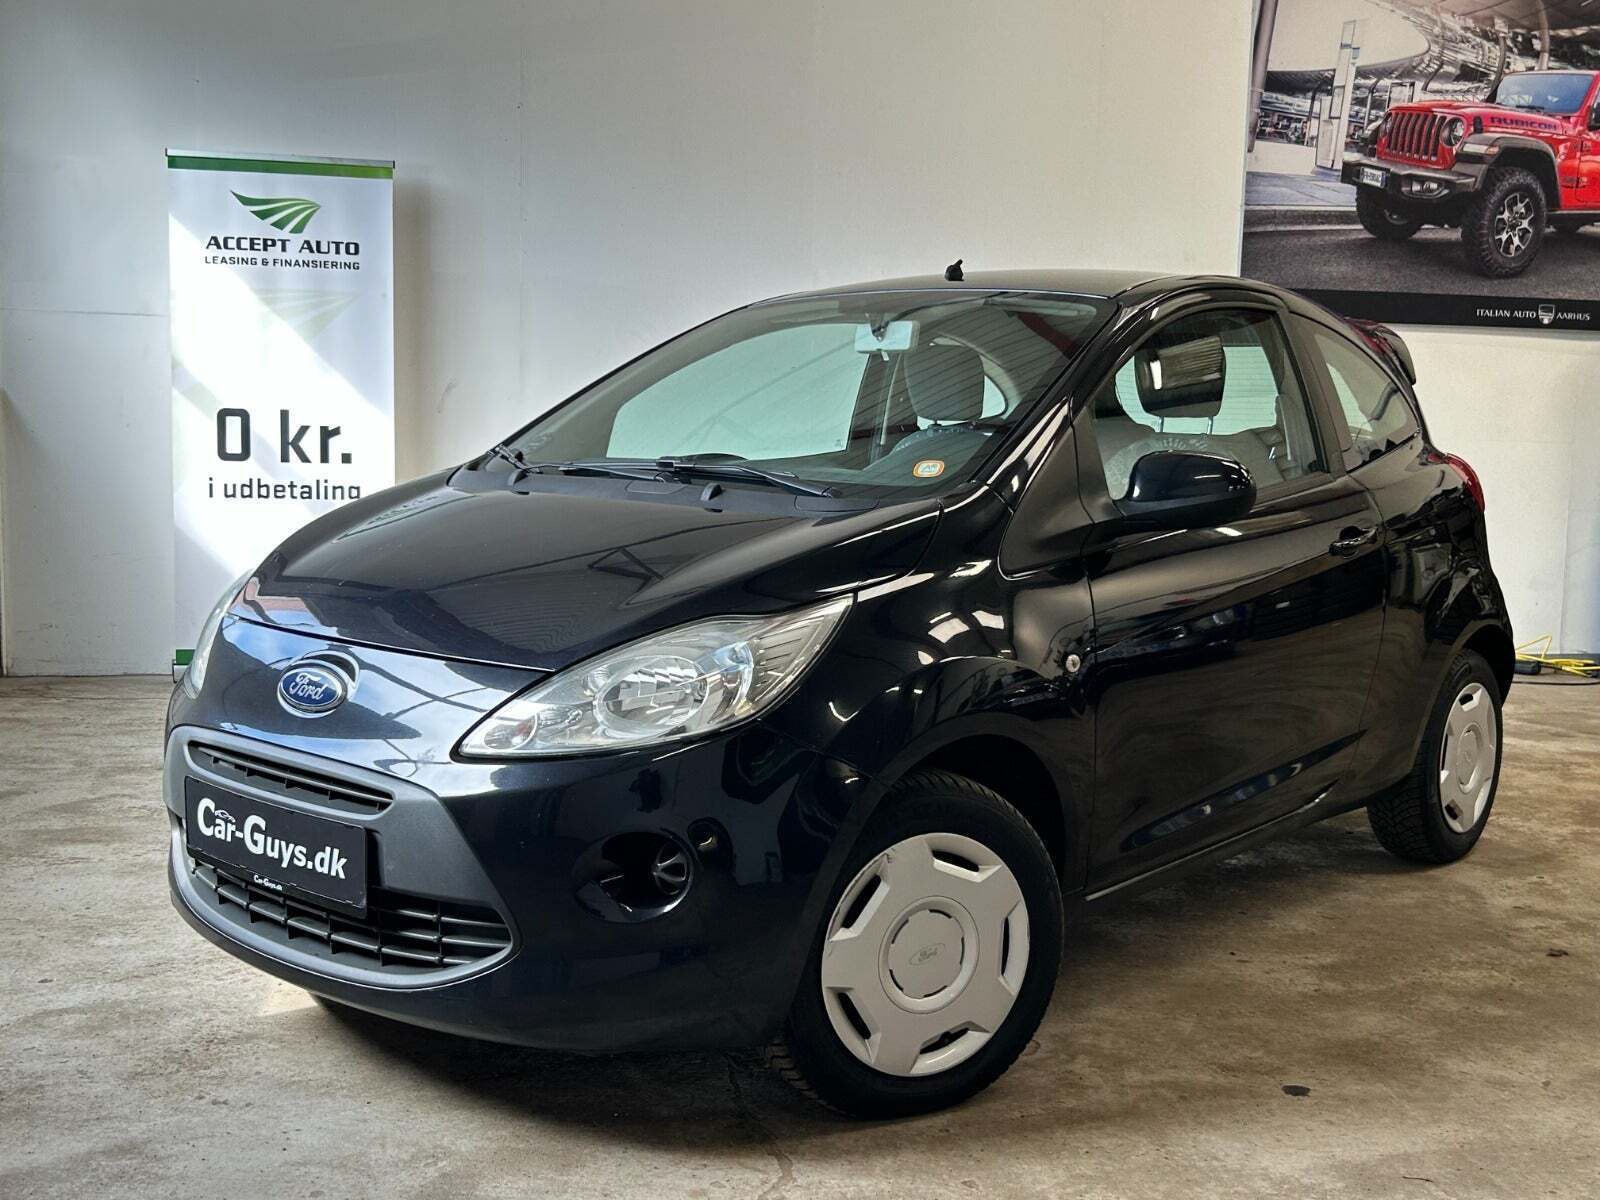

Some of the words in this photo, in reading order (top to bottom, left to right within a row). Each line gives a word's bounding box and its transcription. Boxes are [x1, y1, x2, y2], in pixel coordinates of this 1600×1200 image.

[206, 235, 291, 253] ACCEPT
[299, 239, 360, 256] AUTO
[205, 255, 257, 266] LEASING
[261, 258, 269, 266] &
[273, 258, 360, 270] FINANSIERING
[1476, 308, 1511, 318] ITALIAN
[1513, 310, 1536, 319] AUTO
[1556, 312, 1591, 321] AARHUS
[217, 408, 251, 462] 0
[280, 409, 353, 464] kr.
[208, 477, 214, 498] i
[289, 672, 329, 700] Ford
[197, 797, 348, 880] Car-Guys.dk
